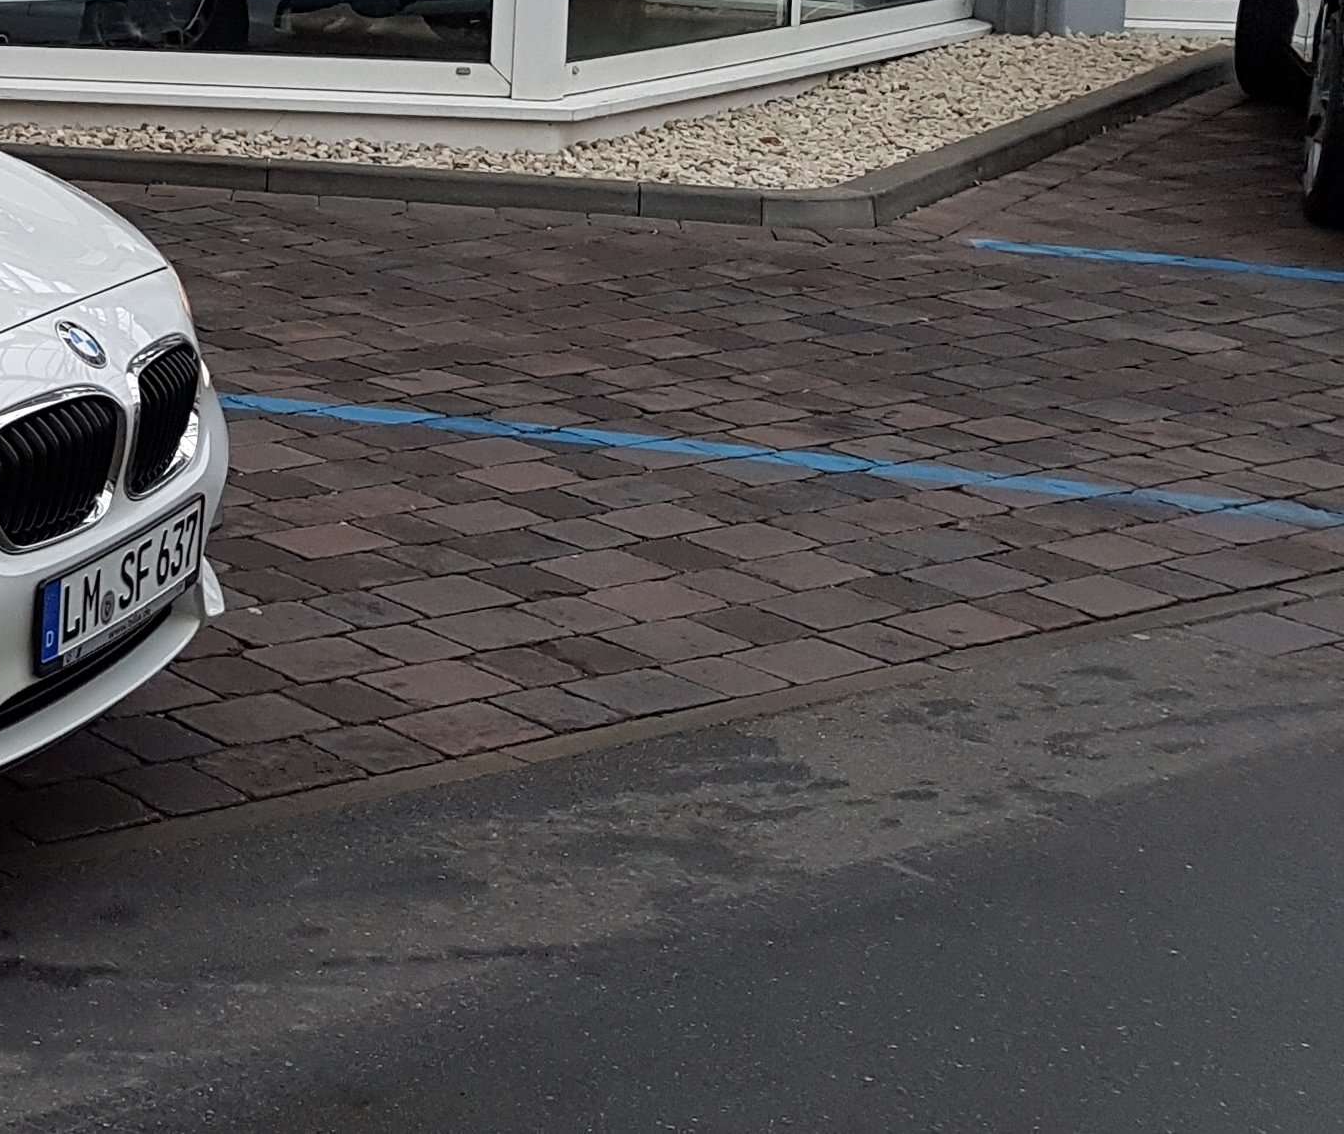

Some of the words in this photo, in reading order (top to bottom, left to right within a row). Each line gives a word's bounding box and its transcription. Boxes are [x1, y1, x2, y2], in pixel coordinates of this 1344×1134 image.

[46, 631, 53, 648] D
[62, 569, 102, 643] LM
[119, 539, 152, 610] SF
[157, 509, 199, 587] 637
